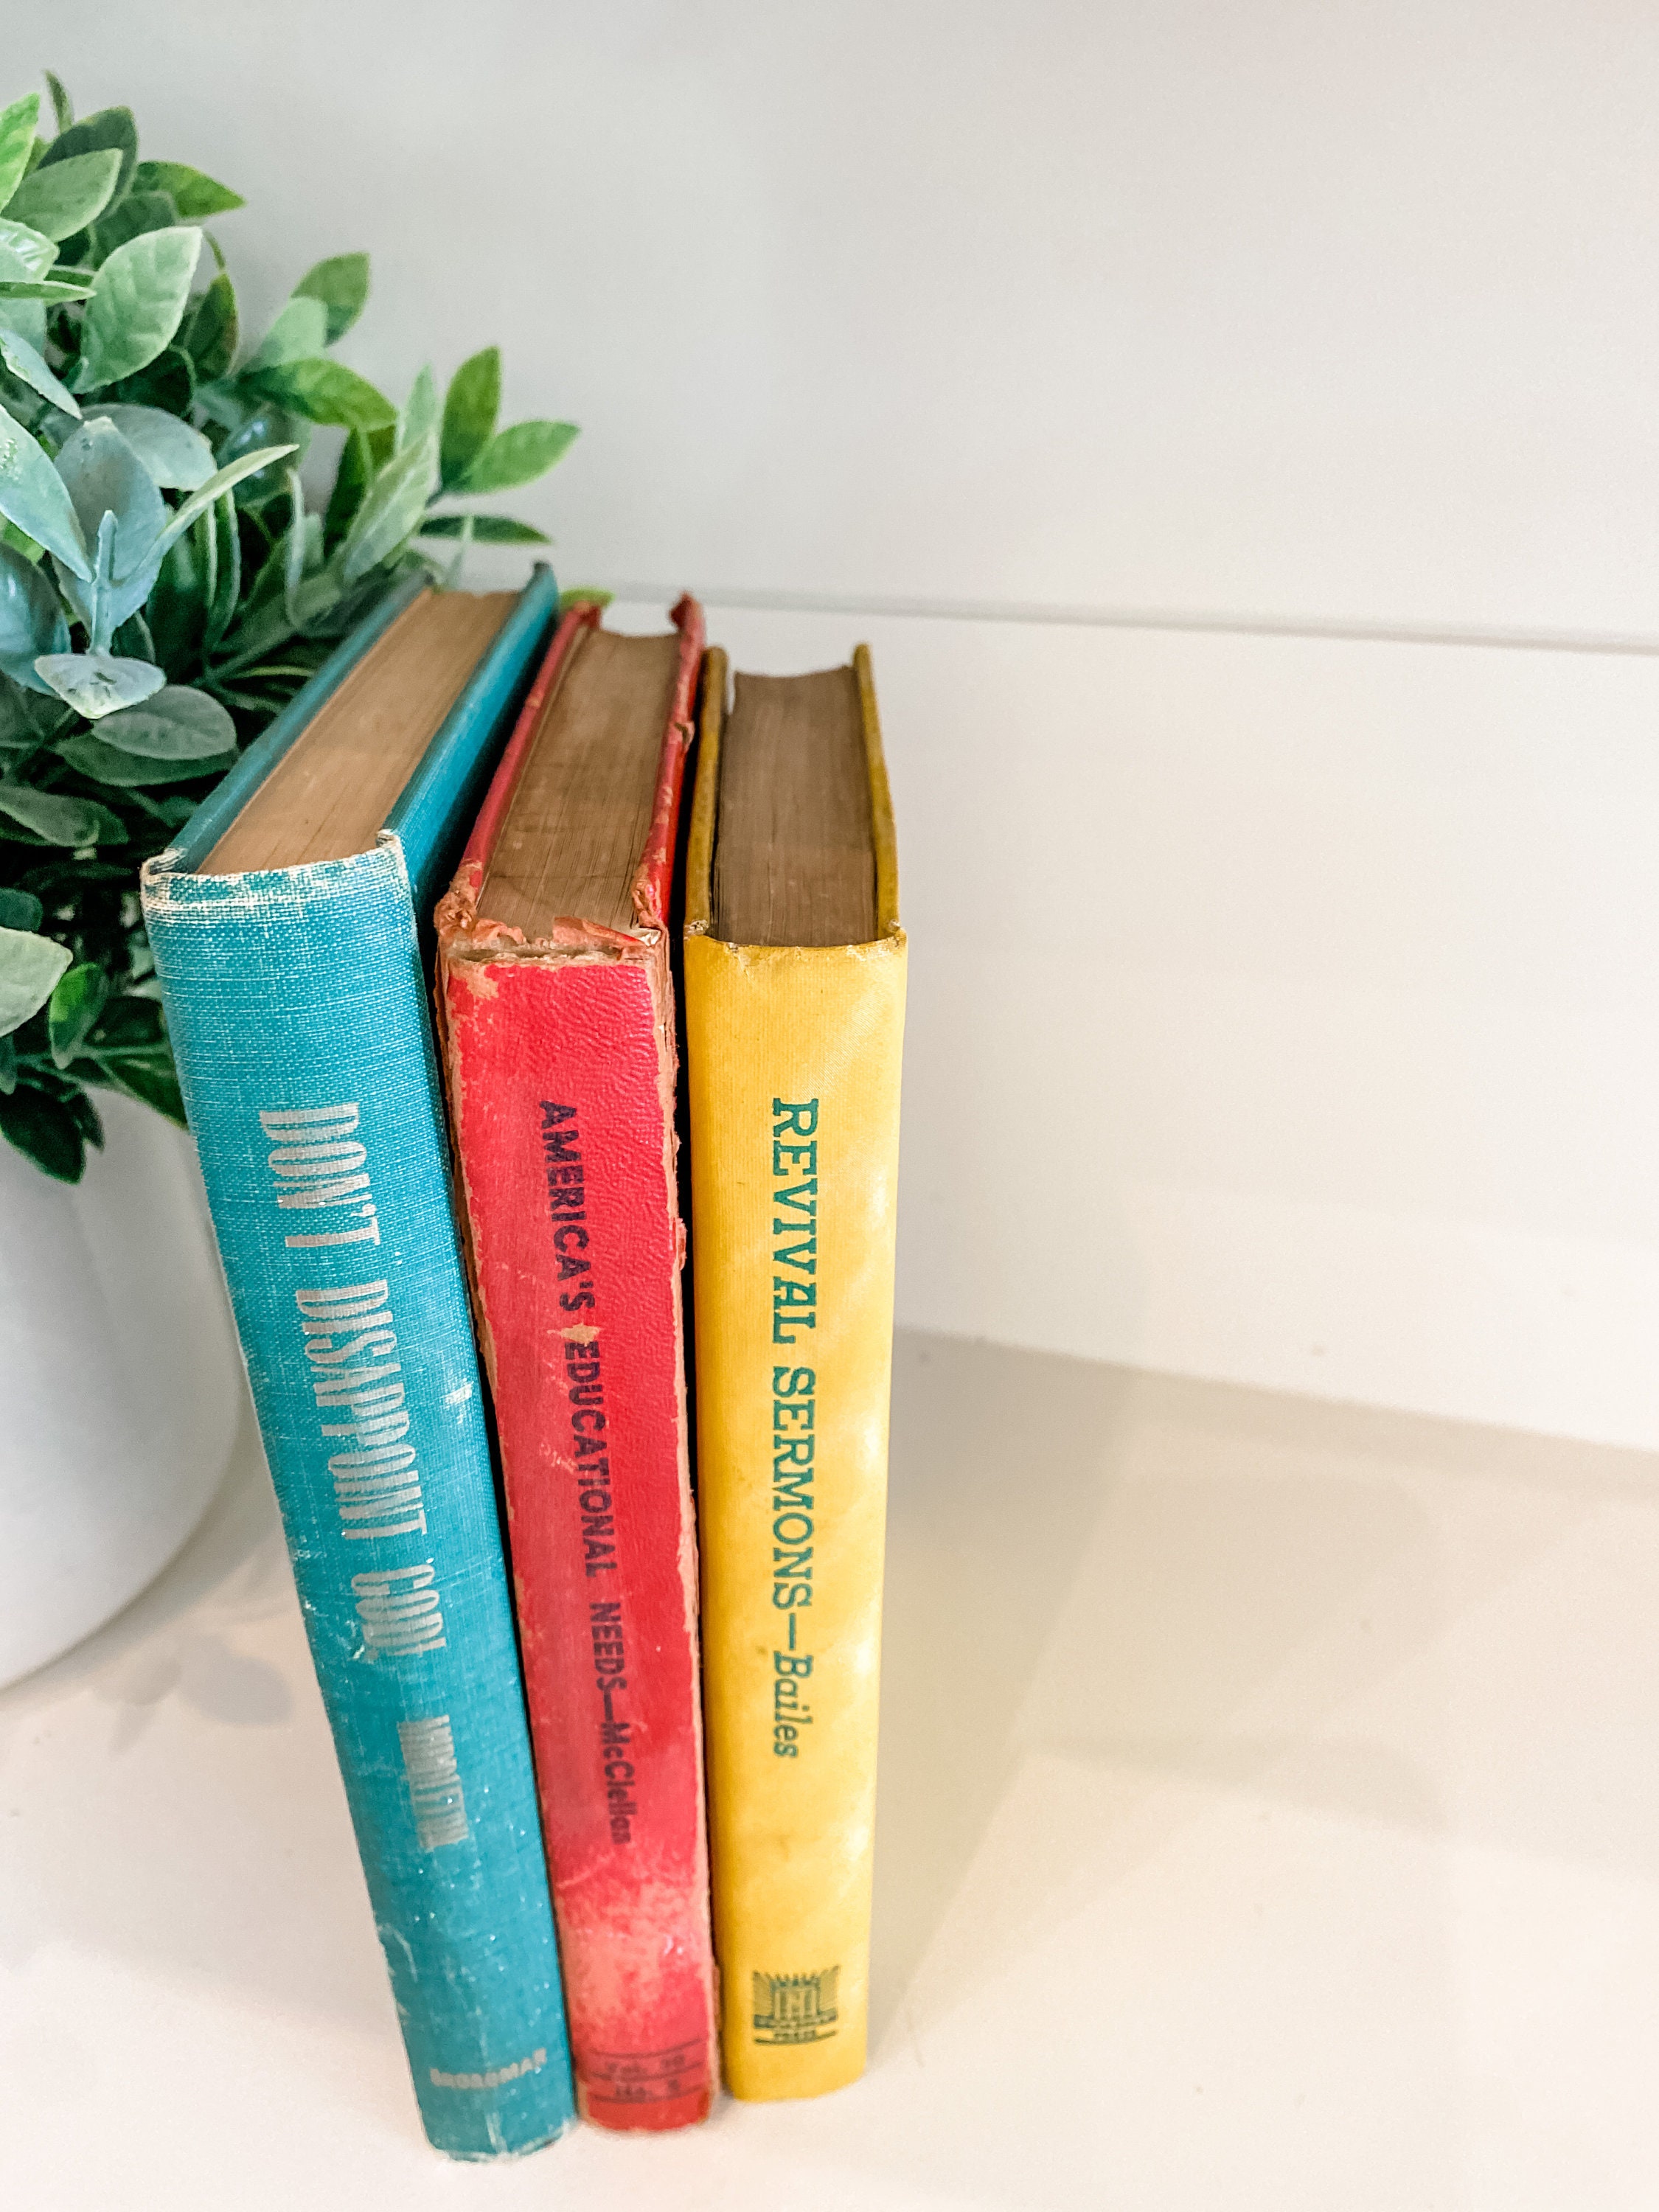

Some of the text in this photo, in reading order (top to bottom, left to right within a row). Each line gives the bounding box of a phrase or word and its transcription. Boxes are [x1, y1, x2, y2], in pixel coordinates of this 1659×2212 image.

[260, 1102, 380, 1248] DON'T
[539, 1099, 595, 1312] AMERICA'S
[772, 1097, 819, 1344] REVIVAL
[296, 1279, 427, 1540] DISAPPOINT
[564, 1340, 617, 1578] EDUCATIONAL
